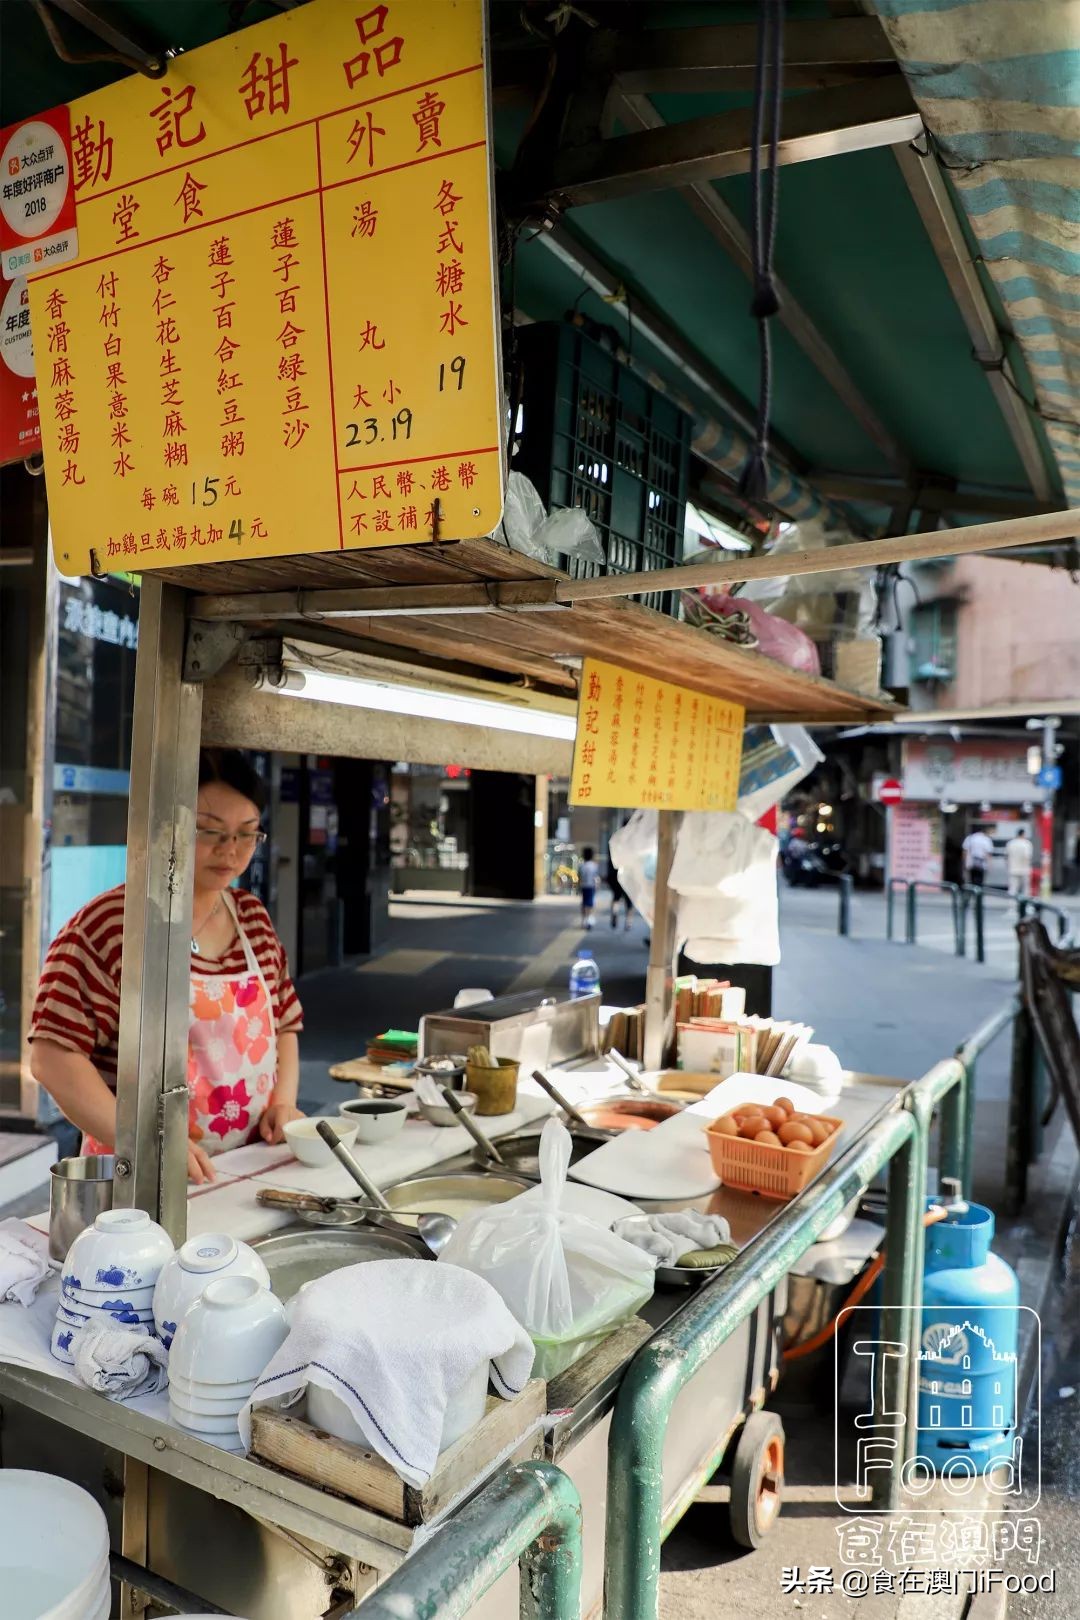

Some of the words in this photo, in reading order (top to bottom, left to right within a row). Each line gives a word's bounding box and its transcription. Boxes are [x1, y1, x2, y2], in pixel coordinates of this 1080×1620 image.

[72, 4, 405, 192] 勤記甜品
[346, 91, 446, 168] 外賣
[2, 164, 65, 200] 年度好评商户
[21, 145, 54, 169] 大众点评
[24, 197, 47, 217] 2018
[112, 172, 208, 245] 堂食
[433, 179, 469, 336] 各式糖水
[45, 288, 86, 487] 香滑麻蓉湯丸
[96, 271, 136, 478] 付竹白果意米水
[151, 256, 189, 467] 杏仁花生芝麻糊
[208, 236, 246, 457] 蓮子百合紅豆粥
[438, 355, 467, 392] 19
[347, 461, 478, 501] 人民幣、港幣
[577, 671, 602, 798] 勤記甜品
